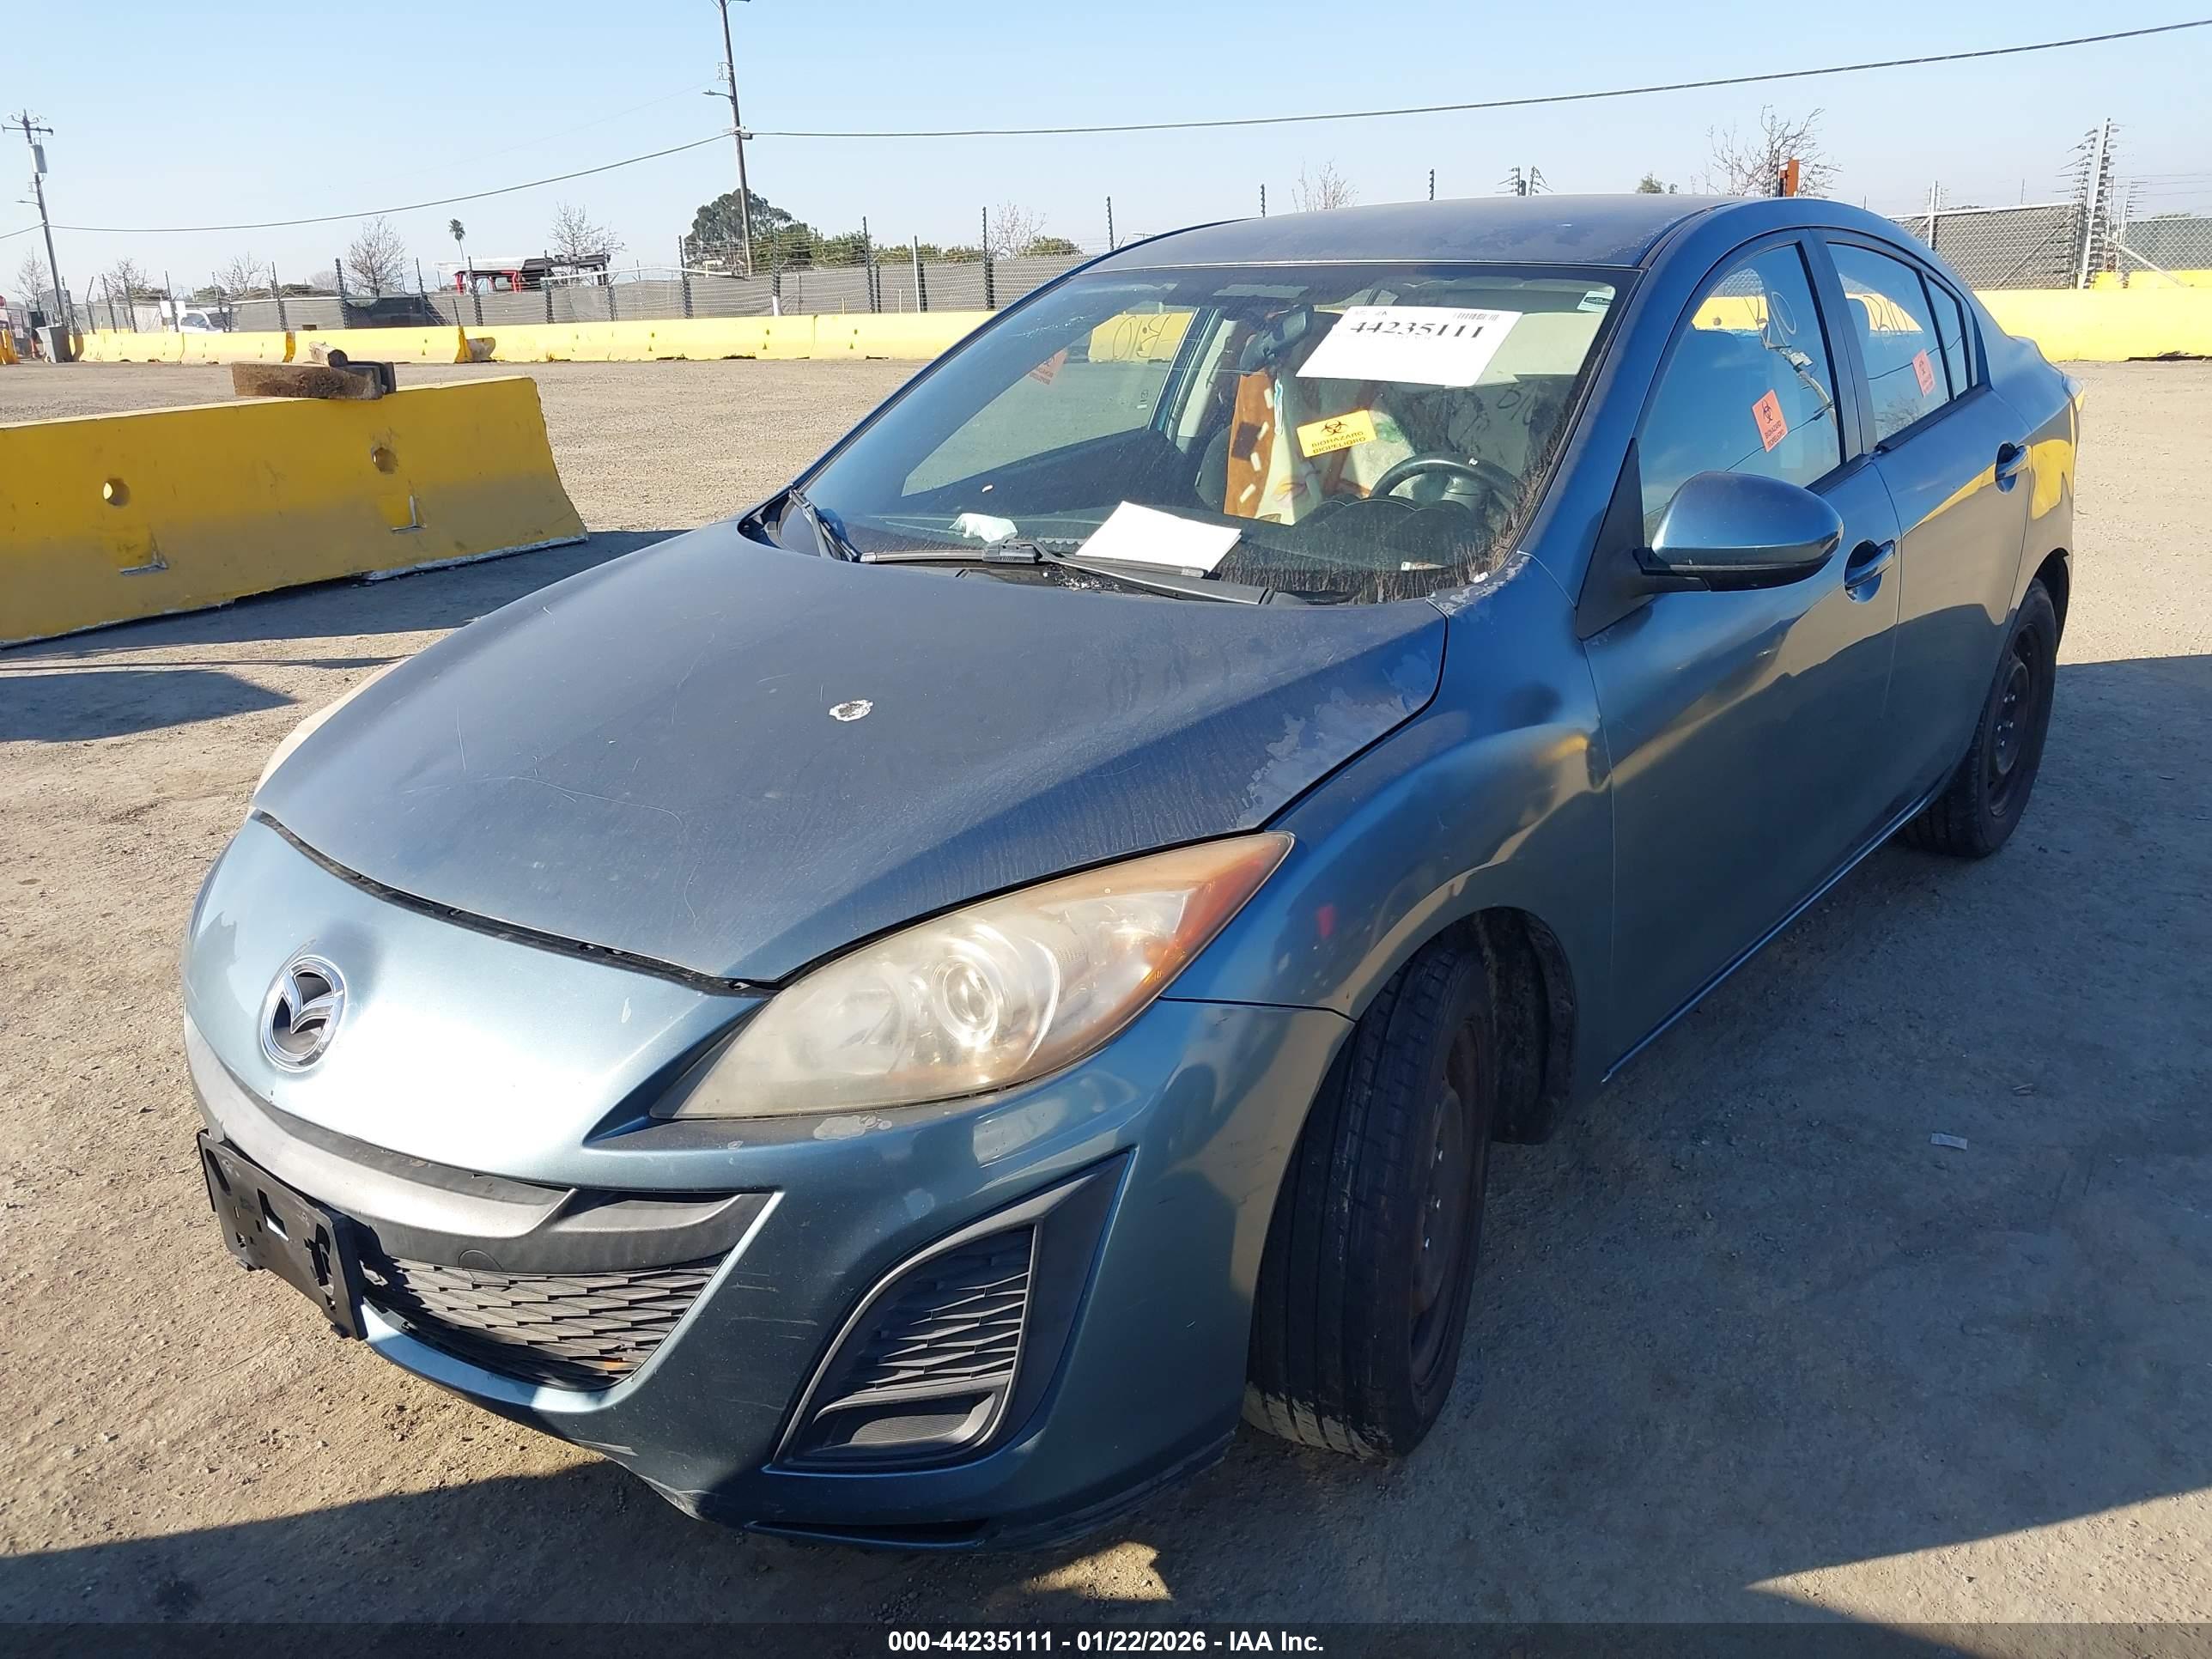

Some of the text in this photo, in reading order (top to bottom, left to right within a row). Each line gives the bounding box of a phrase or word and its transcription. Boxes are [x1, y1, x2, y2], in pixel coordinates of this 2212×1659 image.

[1350, 321, 1485, 338] 44235111
[1311, 431, 1364, 448] BIOHAZARD
[1313, 436, 1366, 454] BIOPELIGRO
